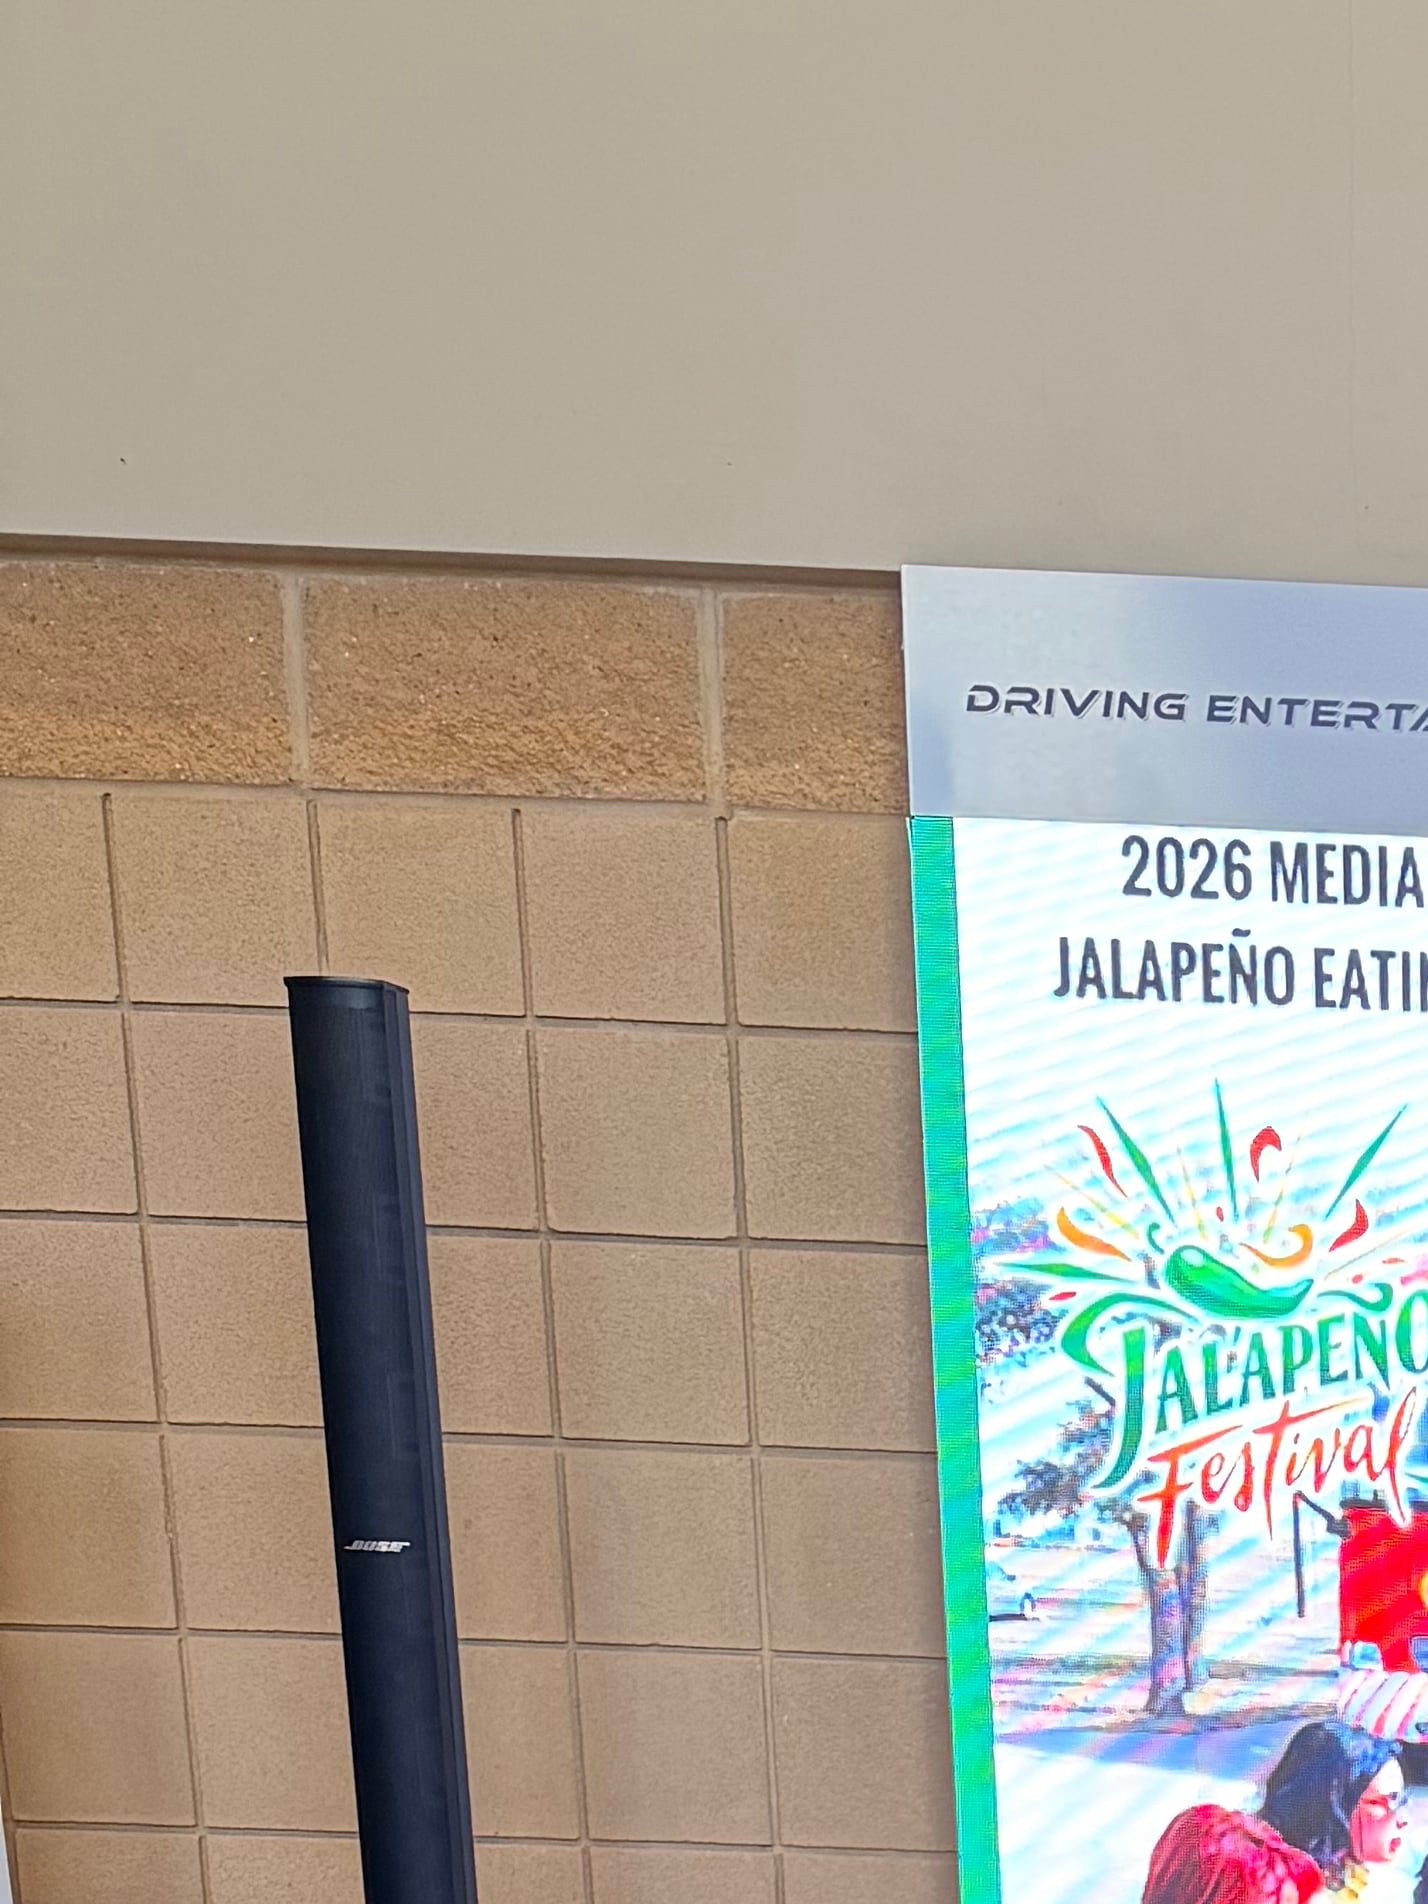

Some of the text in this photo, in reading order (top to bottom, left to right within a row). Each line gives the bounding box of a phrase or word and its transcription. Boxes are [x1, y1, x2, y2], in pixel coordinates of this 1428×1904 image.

[966, 684, 1189, 721] DRIVING
[1122, 835, 1252, 900] 2026
[1054, 928, 1295, 1006] JALAPEÑO
[1139, 1386, 1417, 1569] Festival
